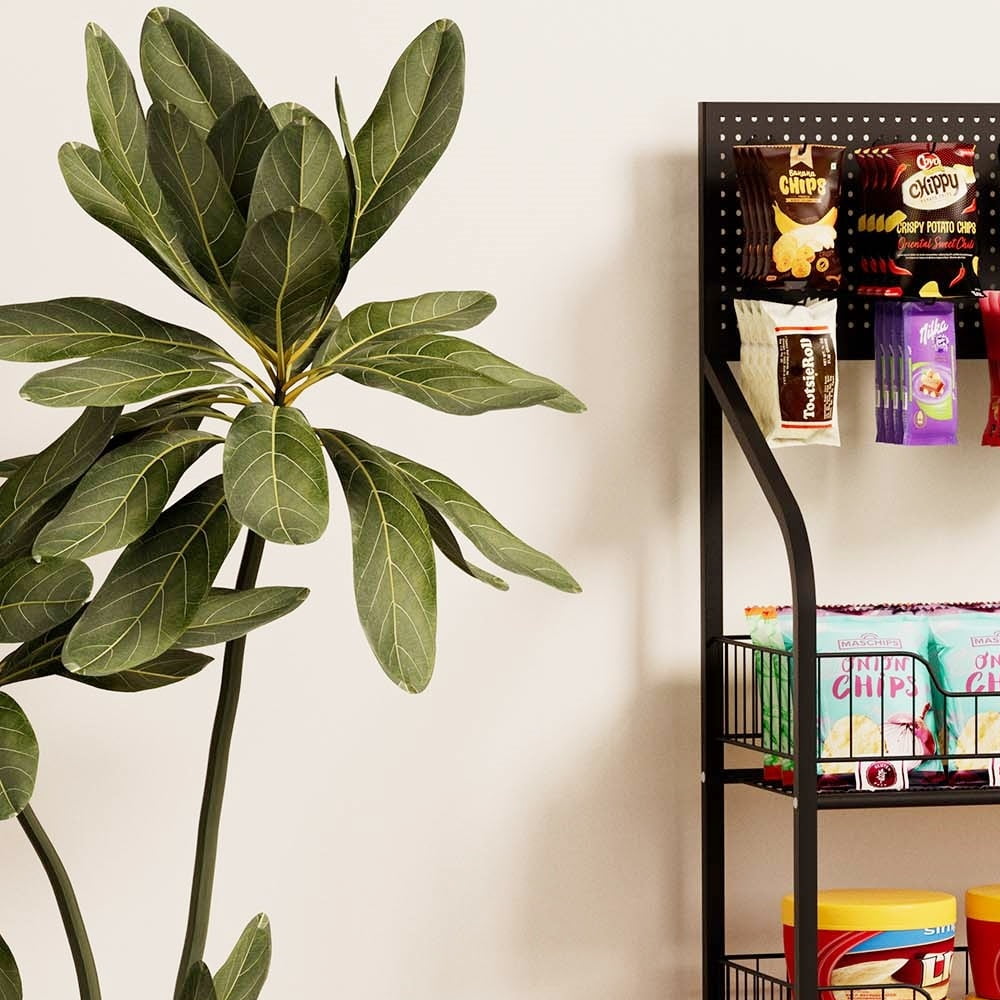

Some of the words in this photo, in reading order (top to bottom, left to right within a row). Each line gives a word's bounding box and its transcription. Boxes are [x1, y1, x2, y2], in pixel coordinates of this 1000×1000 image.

[779, 176, 826, 196] CHIPS
[897, 221, 924, 234] CRISPY
[927, 221, 954, 234] POTATO
[957, 221, 976, 234] CHIPS
[898, 237, 932, 249] Oriental
[932, 236, 955, 249] Sweet
